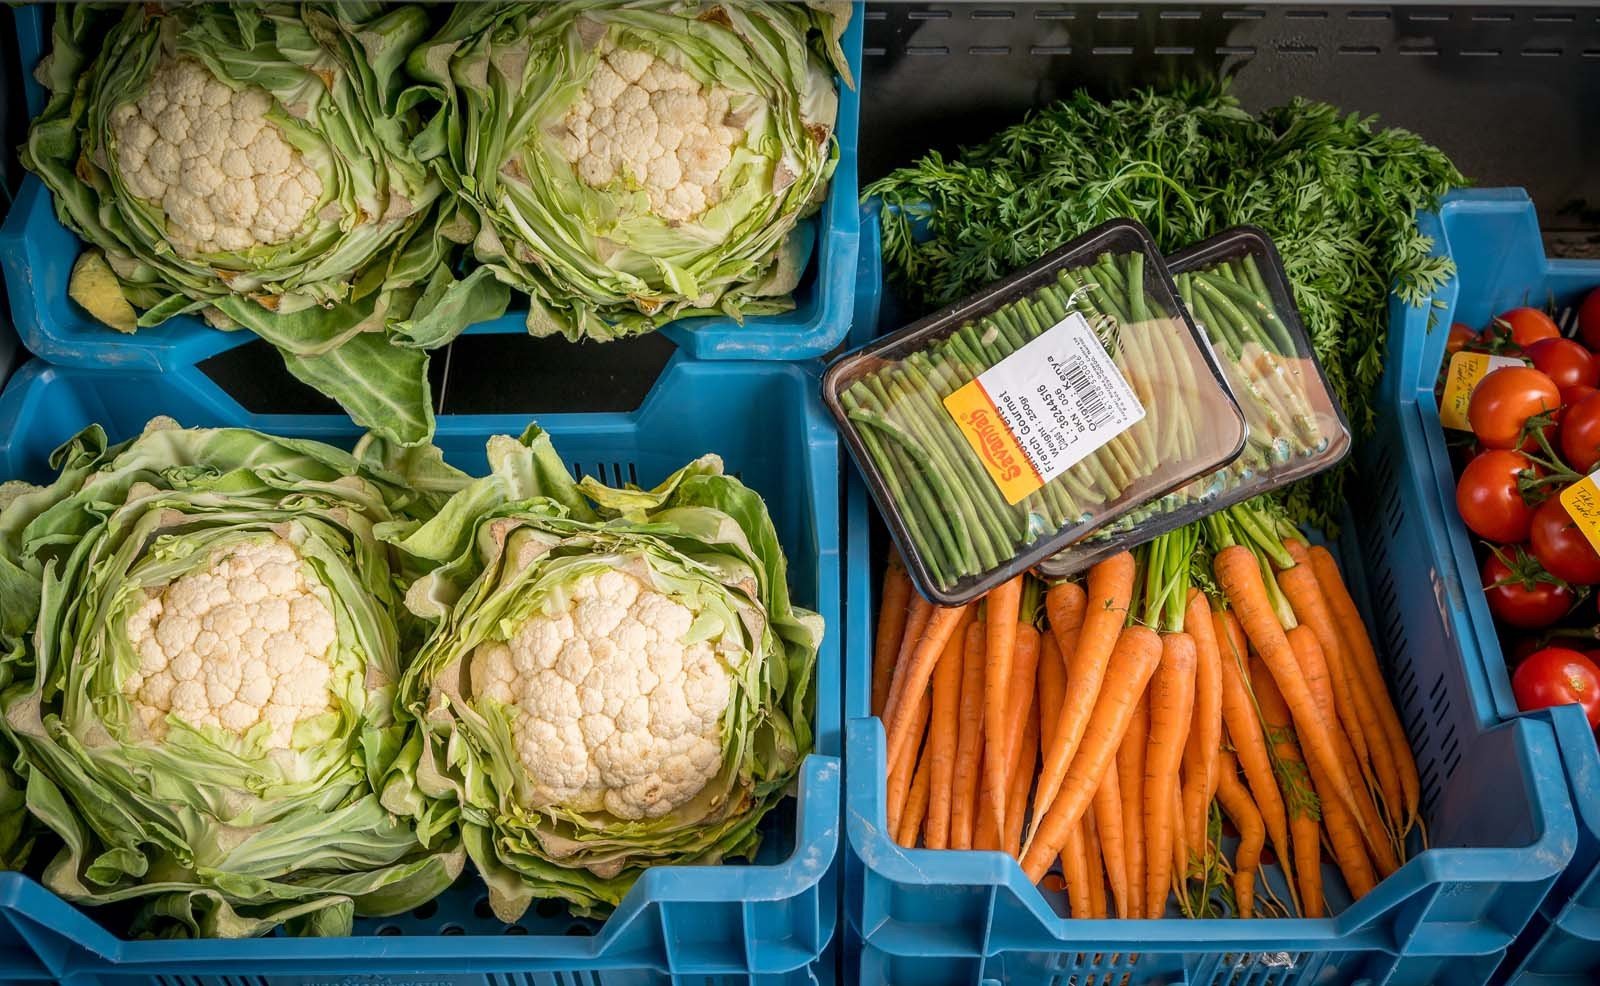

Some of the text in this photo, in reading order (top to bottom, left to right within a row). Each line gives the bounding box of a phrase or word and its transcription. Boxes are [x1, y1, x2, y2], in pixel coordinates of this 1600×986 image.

[1047, 355, 1072, 391] Kenya
[1018, 395, 1038, 422] 250gr
[1036, 384, 1069, 429] 36244516
[1054, 387, 1069, 406] 036
[998, 390, 1055, 473] French Gourmet
[1069, 412, 1086, 433] BKN
[1075, 399, 1097, 432] Origin
[966, 409, 1021, 482] Savannah
[991, 404, 1045, 480] Haricots Verts
[1037, 426, 1060, 458] Weight
[1053, 431, 1069, 451] Class
[1070, 434, 1079, 445] L
[1577, 486, 1595, 508] Take
